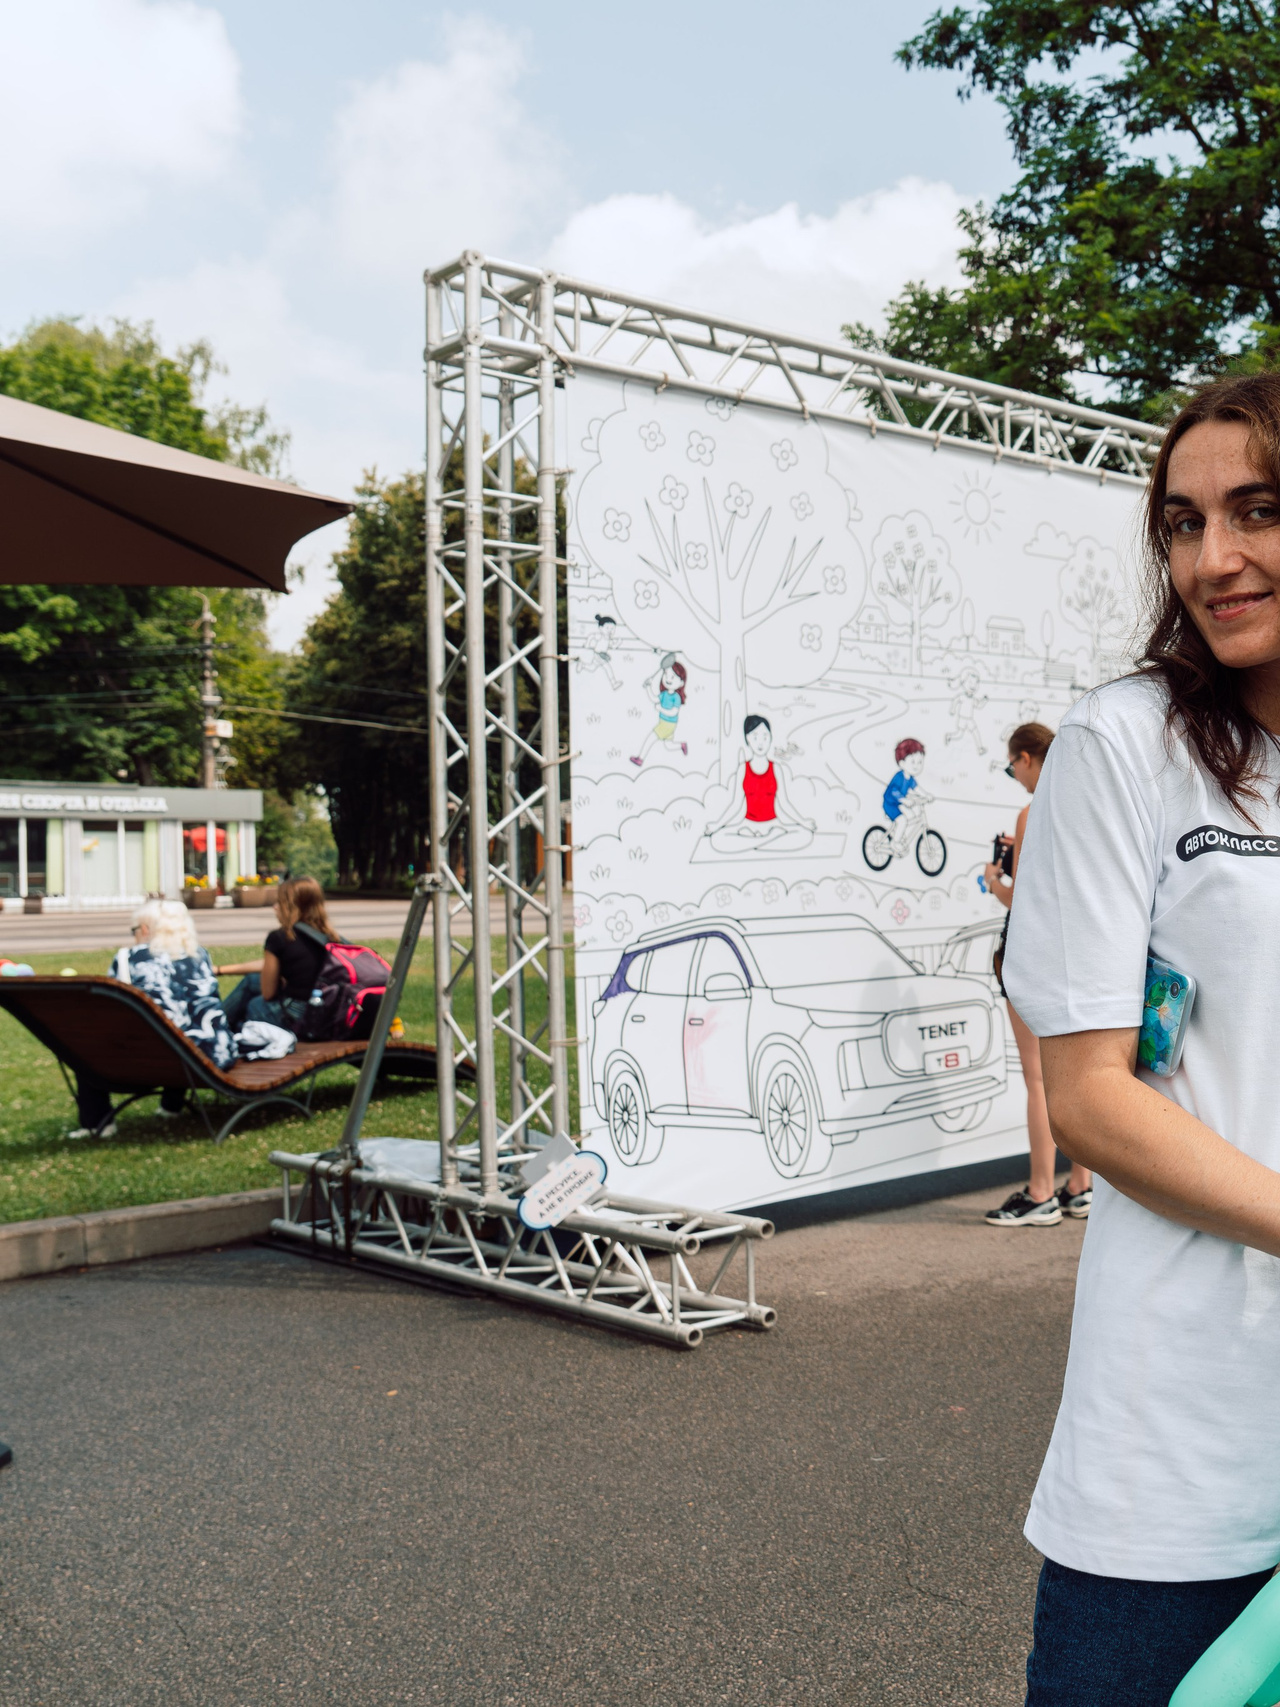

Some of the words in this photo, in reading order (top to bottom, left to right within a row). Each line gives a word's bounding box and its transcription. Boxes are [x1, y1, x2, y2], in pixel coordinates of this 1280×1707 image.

[1185, 830, 1279, 855] АВТОКЛАСС
[918, 1020, 968, 1041] TENET
[936, 1053, 960, 1068] T8
